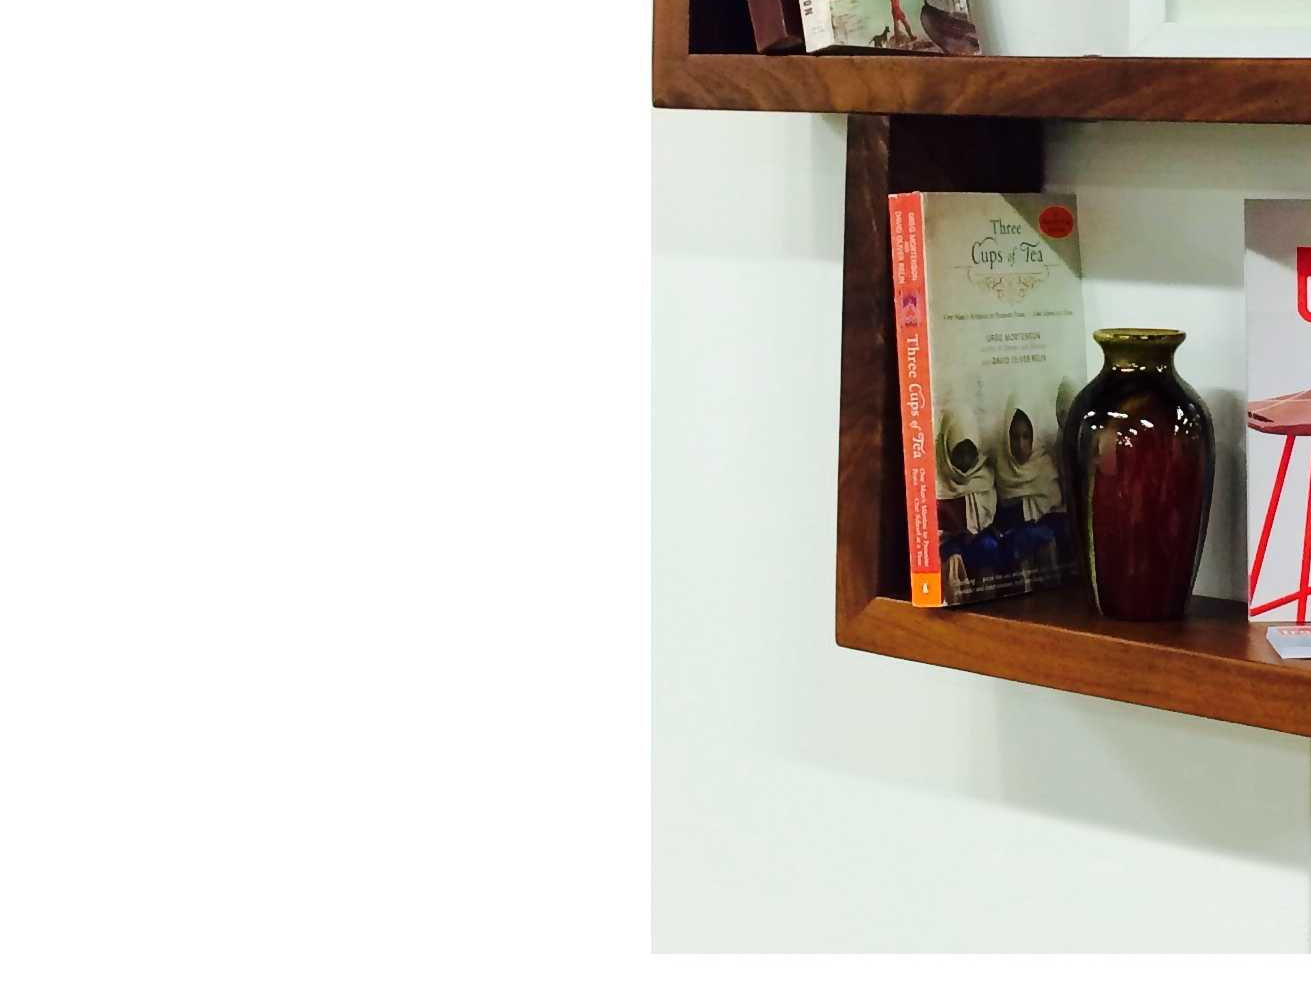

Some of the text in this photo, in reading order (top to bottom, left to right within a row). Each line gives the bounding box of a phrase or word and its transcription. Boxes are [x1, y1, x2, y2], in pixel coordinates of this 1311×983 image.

[989, 217, 1022, 235] Three
[971, 236, 1044, 270] Cups of Tea
[906, 334, 920, 378] Three
[906, 383, 925, 417] Cups
[912, 432, 926, 459] Tea
